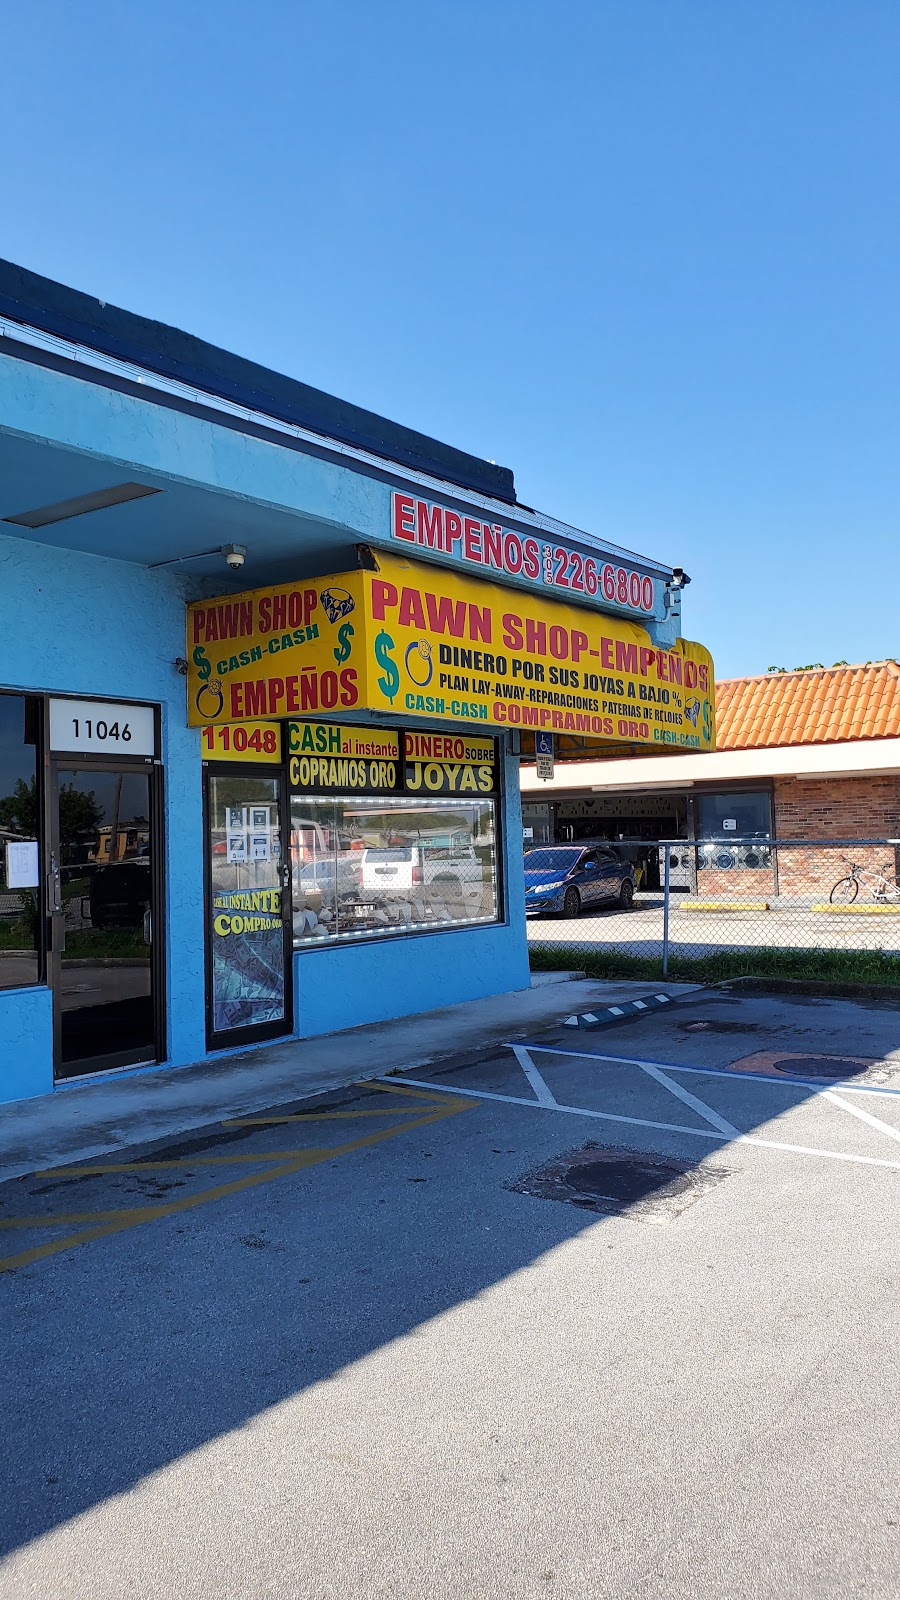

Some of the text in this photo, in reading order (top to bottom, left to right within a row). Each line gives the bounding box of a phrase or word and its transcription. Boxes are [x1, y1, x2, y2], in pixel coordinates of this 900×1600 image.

[392, 492, 541, 580] EMPEÑOS
[554, 547, 654, 611] 226-6800
[193, 589, 318, 644] PAWN SHOP
[371, 578, 492, 644] PAWN
[216, 623, 320, 675] CASH-CASH
[230, 666, 359, 718] EMPEÑOS
[439, 643, 507, 676] DINERO
[512, 658, 545, 682] POR
[548, 666, 580, 689] SUS
[583, 672, 625, 697] JOYAS
[627, 681, 636, 699] A
[639, 684, 670, 705] BAJO
[405, 693, 488, 719] CASH-CASH
[492, 701, 614, 736] COMPRAMOS
[617, 719, 650, 739] ORO
[439, 672, 469, 692] PLAN
[602, 700, 642, 718] PATERIAS
[643, 707, 653, 720] DE
[654, 709, 683, 726] RELOJES
[72, 718, 132, 742] 11046
[202, 725, 277, 754] 11048
[288, 723, 398, 758] CASH al instante
[405, 734, 494, 762] DINERO SOBRE
[289, 756, 396, 789] COPRAMOS ORO
[406, 762, 494, 792] JOYAS
[229, 889, 281, 913] INSTANTE
[213, 914, 271, 937] COMPRO
